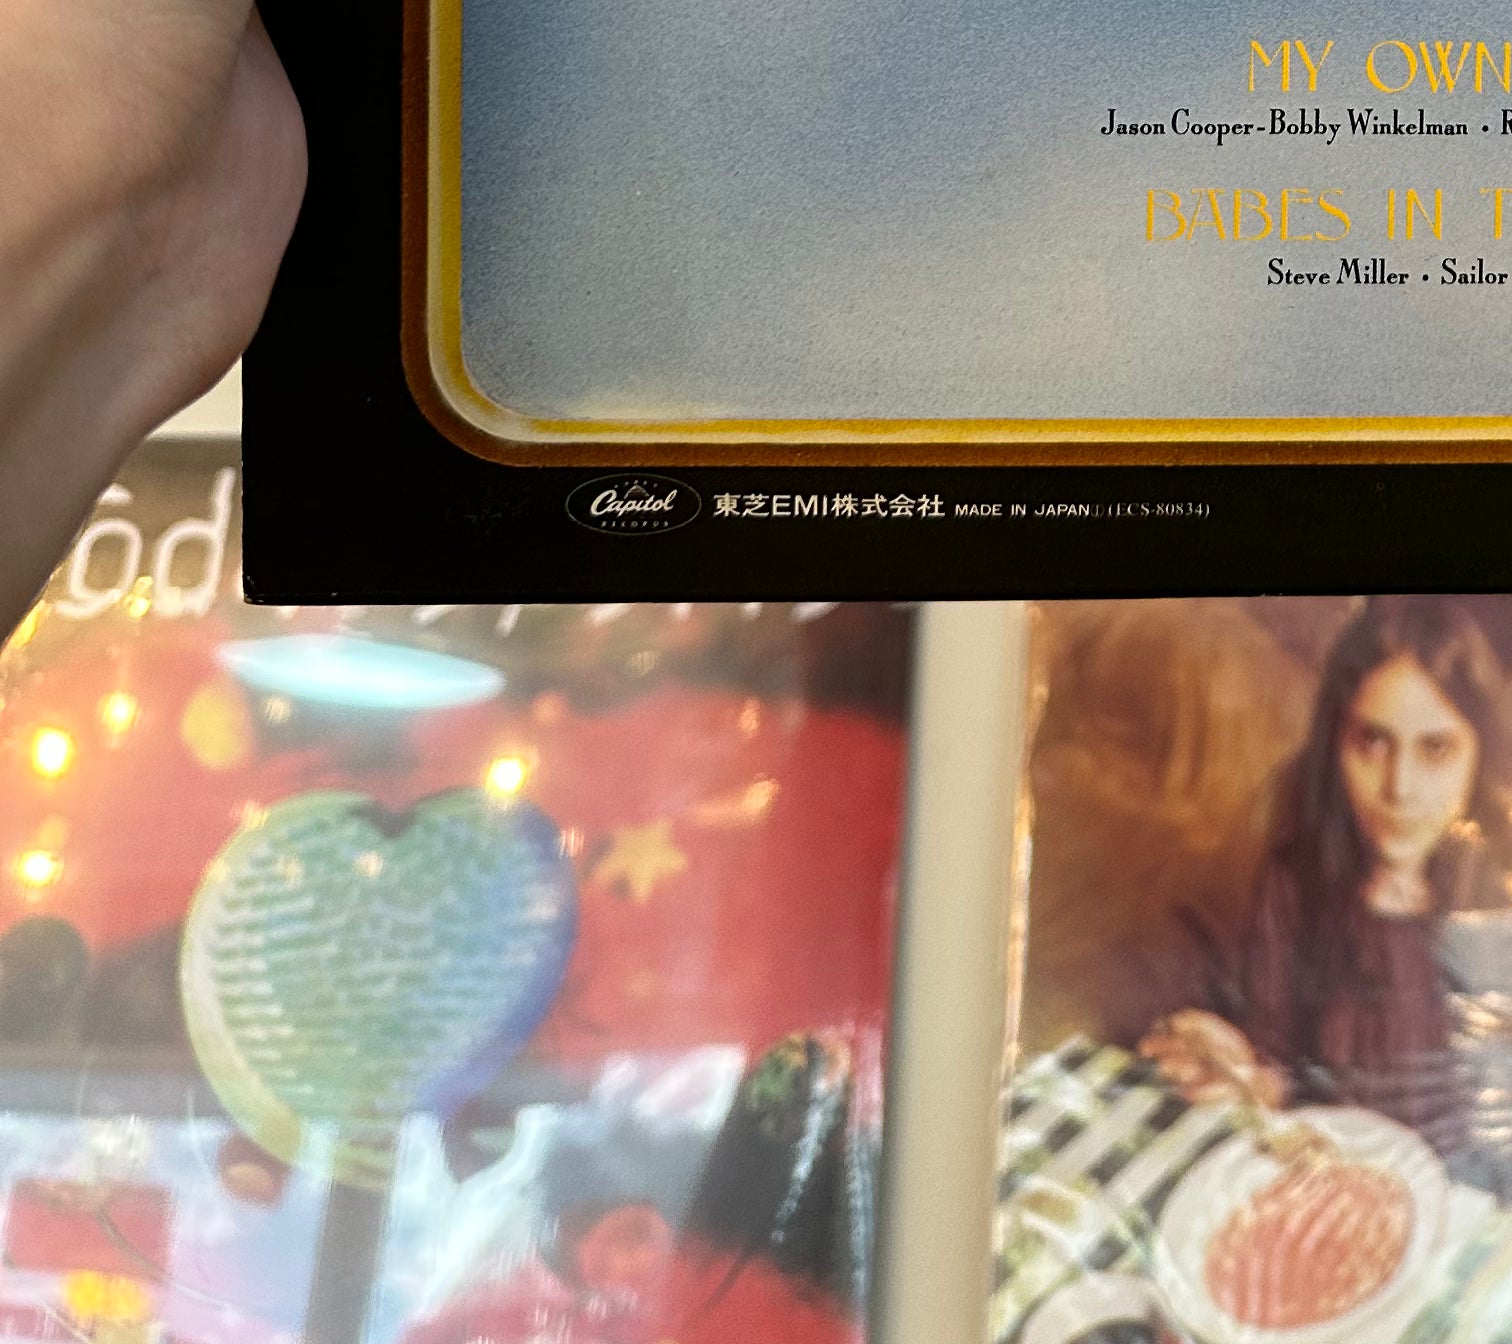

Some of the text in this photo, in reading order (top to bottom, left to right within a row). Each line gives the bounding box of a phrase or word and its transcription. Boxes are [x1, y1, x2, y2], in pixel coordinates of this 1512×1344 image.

[1248, 40, 1333, 92] MY
[1366, 41, 1511, 93] OWN
[1101, 109, 1165, 135] Jason
[1171, 108, 1341, 146] Cooper-Bobby
[1347, 108, 1468, 135] Winkelman
[1146, 189, 1351, 241] BABES
[1388, 189, 1442, 240] IN
[1268, 258, 1330, 285] Steve
[1336, 258, 1409, 284] Miller
[1441, 258, 1508, 284] Sailor
[590, 489, 678, 519] Capitol
[714, 493, 945, 517] 東芝EMI株式会社
[955, 504, 1002, 516] MADE
[1011, 504, 1026, 516] IN
[1035, 504, 1089, 516] JAPAN
